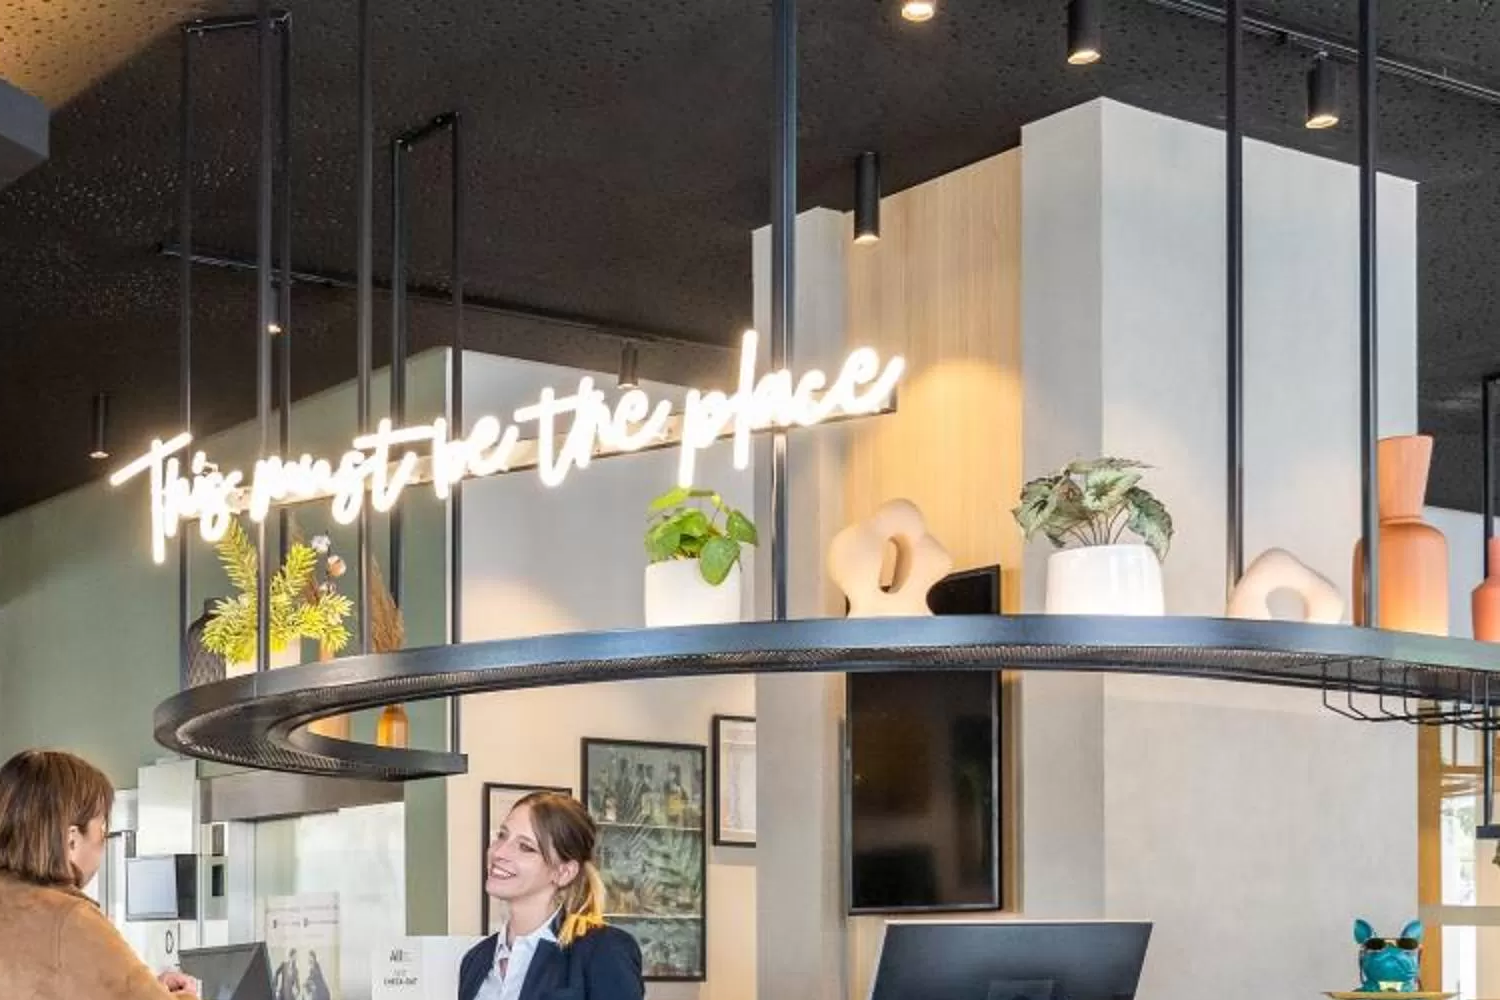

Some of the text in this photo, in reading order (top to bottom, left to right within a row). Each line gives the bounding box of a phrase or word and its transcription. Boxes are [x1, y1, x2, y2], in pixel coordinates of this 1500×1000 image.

[109, 329, 906, 564] This must be the place
